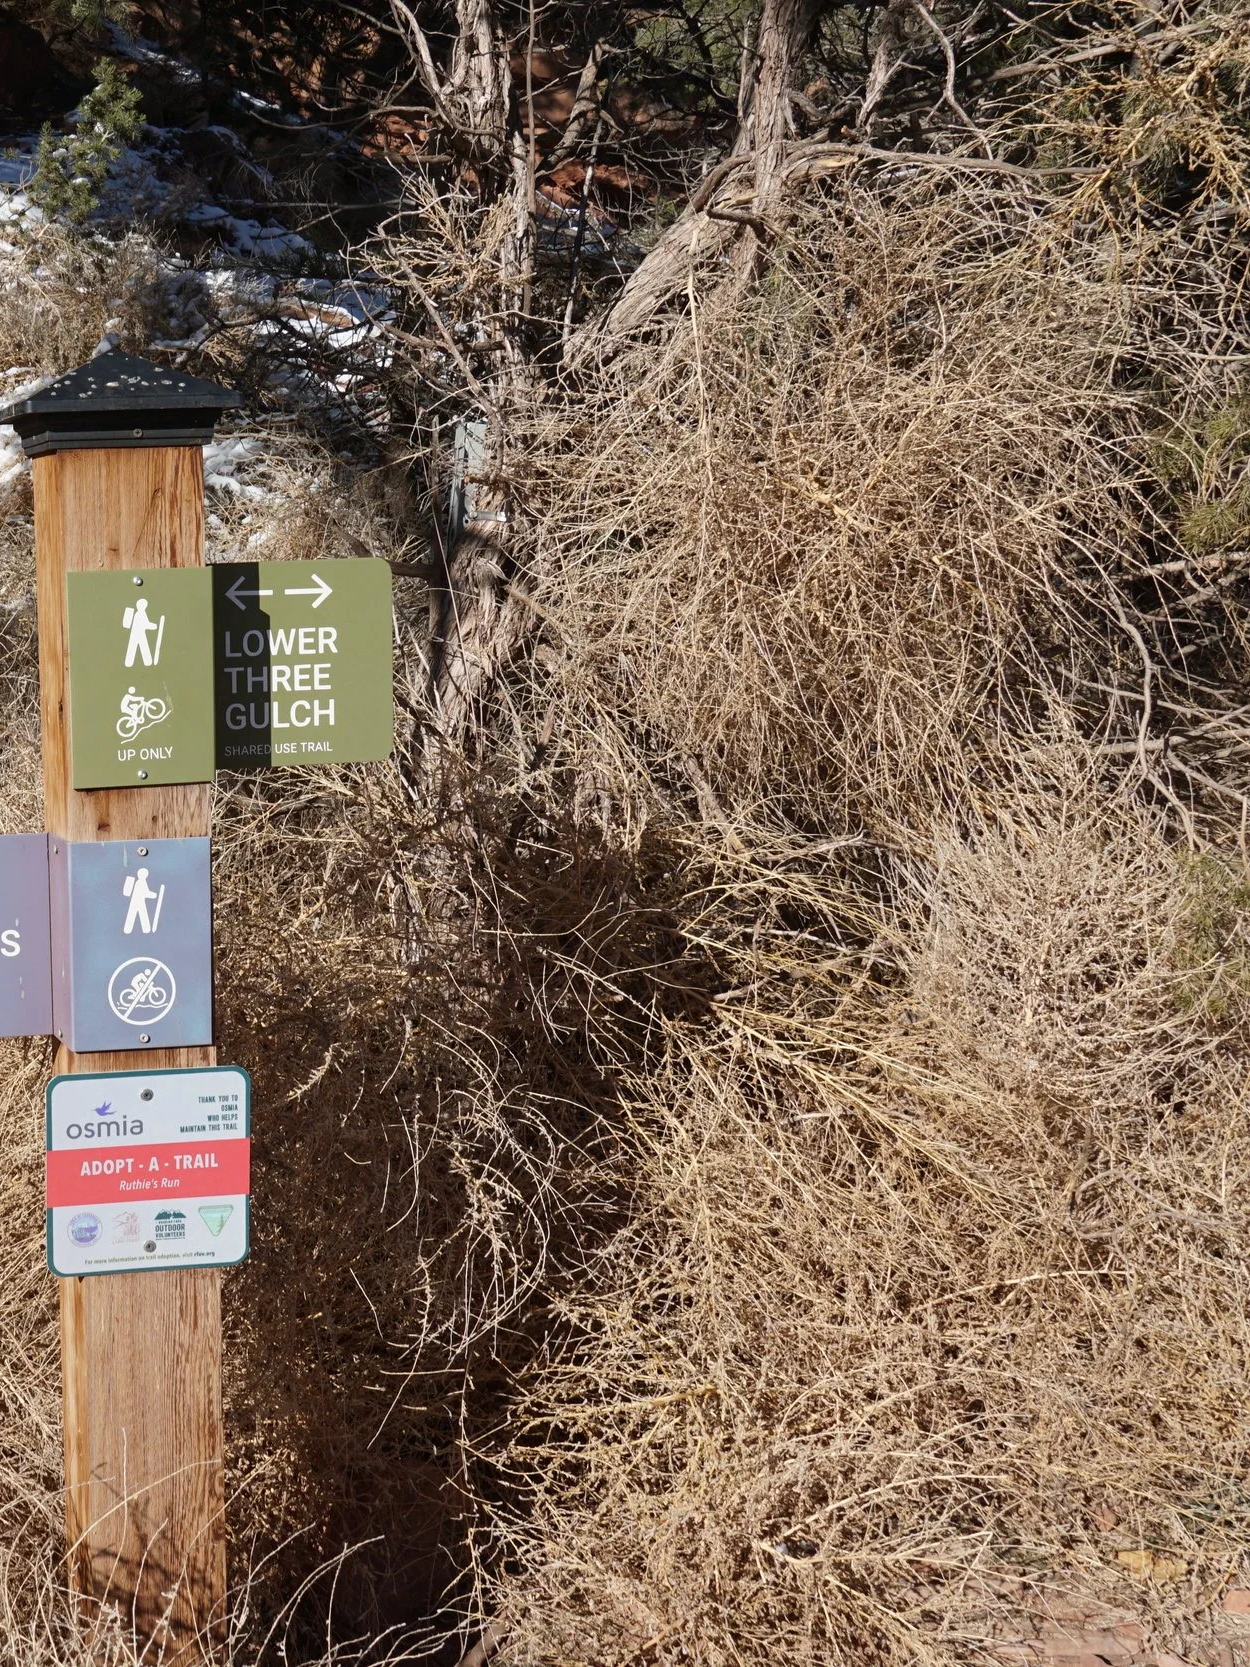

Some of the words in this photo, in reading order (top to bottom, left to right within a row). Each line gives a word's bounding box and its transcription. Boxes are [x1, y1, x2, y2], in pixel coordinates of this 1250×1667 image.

[224, 627, 338, 657] LOWER
[224, 663, 331, 694] THREE
[225, 698, 335, 730] GULCH
[117, 748, 136, 761] UP
[139, 746, 173, 760] ONLY
[224, 744, 271, 757] SHARED
[274, 742, 298, 753] USE
[300, 741, 333, 753] TRAIL
[198, 1096, 216, 1104] THANK
[231, 1094, 238, 1102] TO
[221, 1104, 238, 1112] OSMIA
[207, 1114, 219, 1122] WHO
[221, 1113, 238, 1121] HELPS
[66, 1114, 144, 1139] osmia
[180, 1125, 206, 1133] MAINTAIN
[80, 1158, 135, 1177] ADOPT
[174, 1153, 219, 1170] TRAIL
[119, 1179, 158, 1191] Ruthie's
[160, 1177, 180, 1188] Run
[155, 1223, 185, 1232] OUTDOOR
